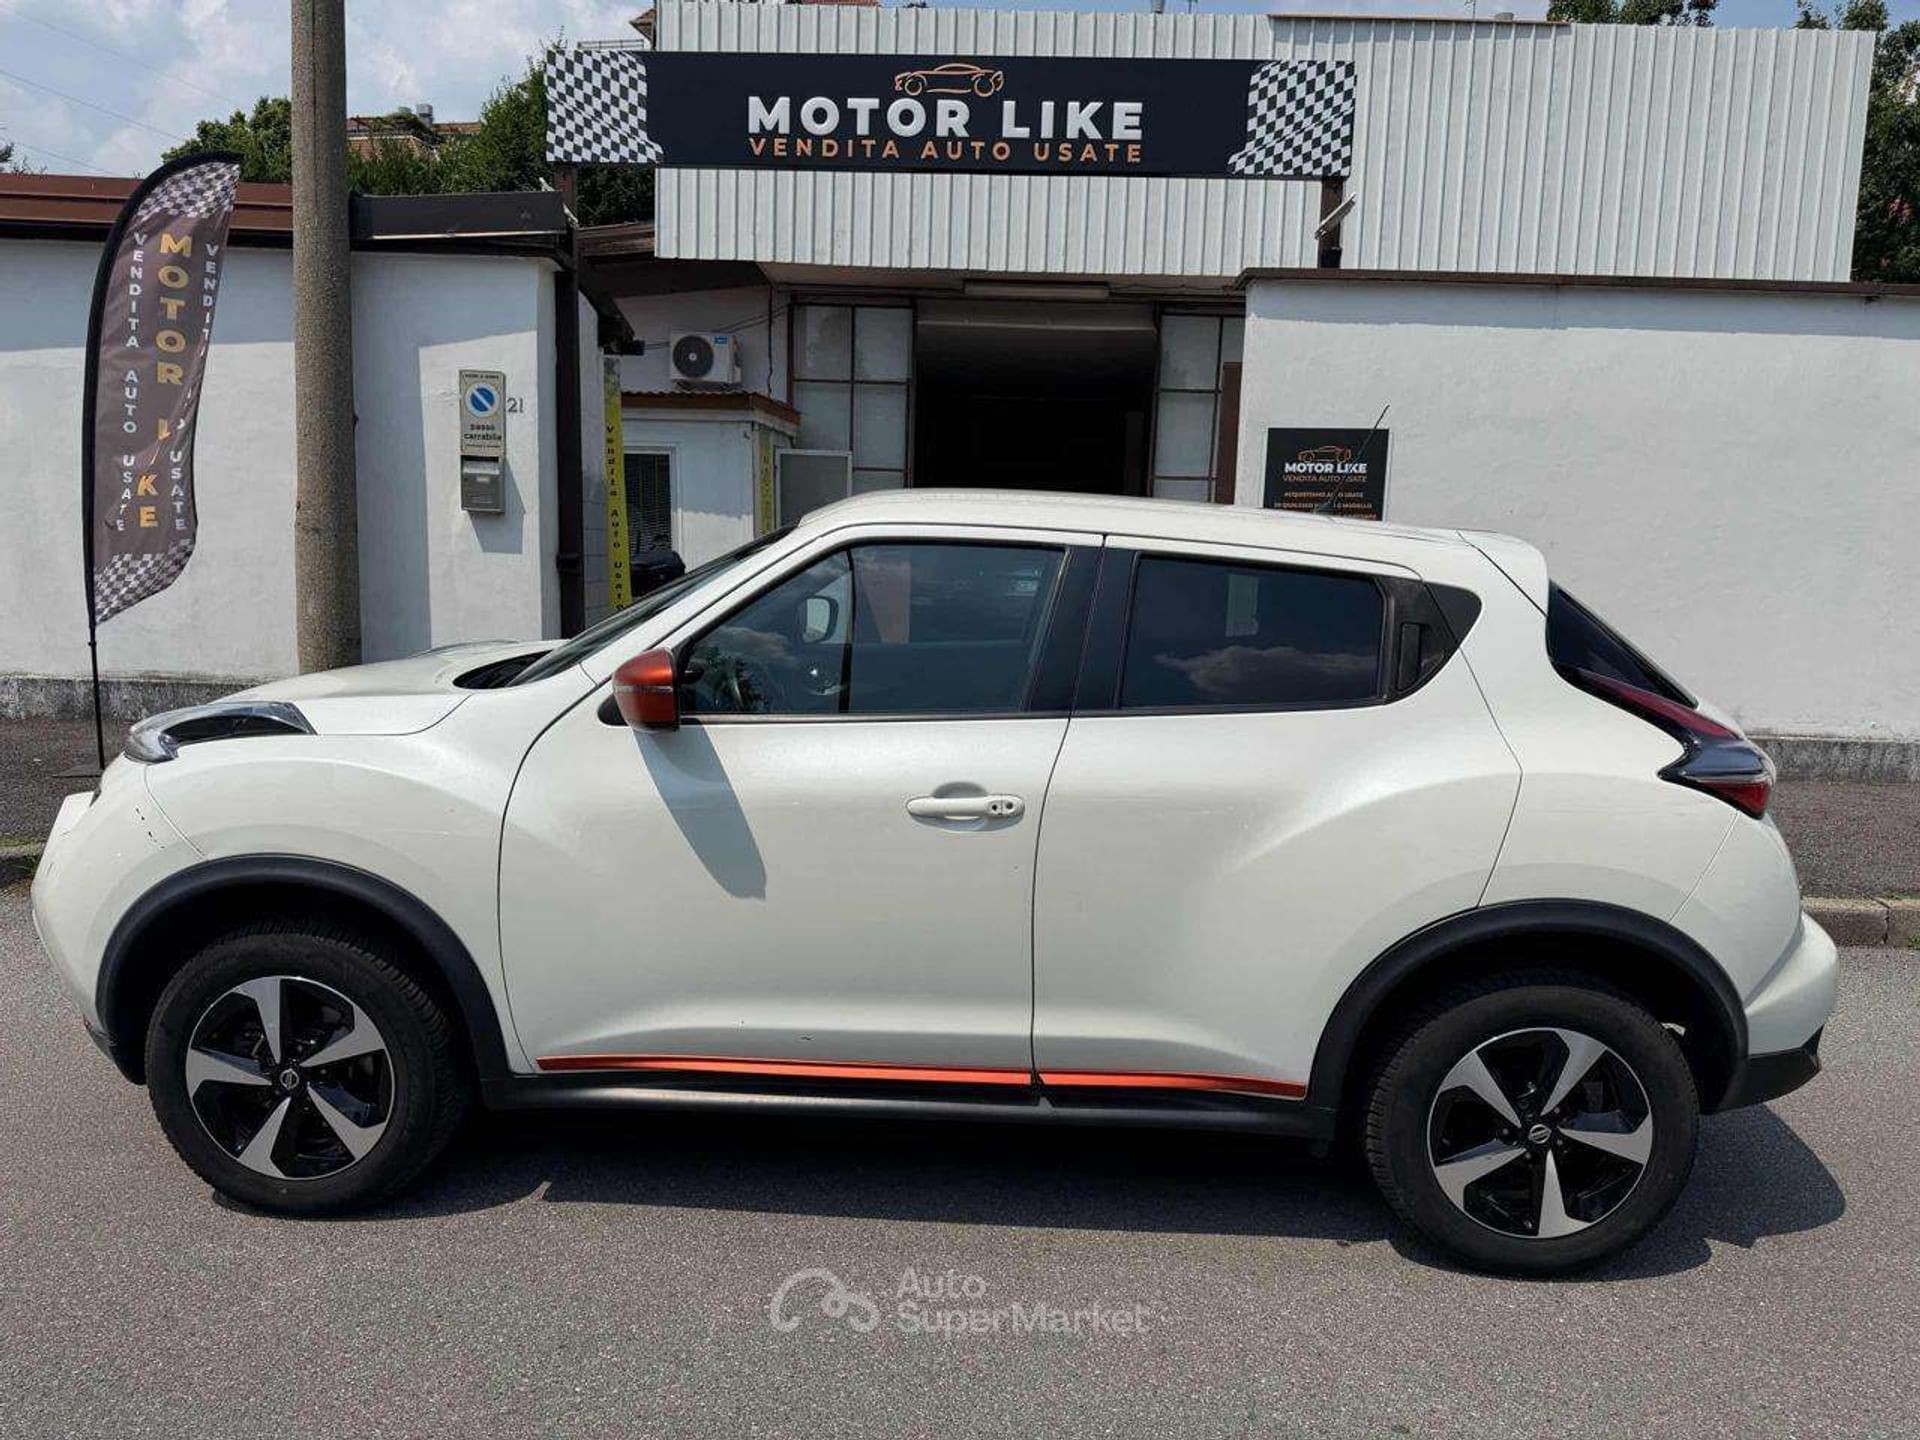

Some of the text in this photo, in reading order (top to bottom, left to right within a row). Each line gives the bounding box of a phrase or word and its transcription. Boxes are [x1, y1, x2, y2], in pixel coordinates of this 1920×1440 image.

[748, 95, 1143, 140] MOTOR LIKE
[748, 137, 1142, 163] VENDITA AUTO USATE
[155, 232, 193, 386] MOTOR
[115, 232, 149, 532] VENDITA AUTO USATE
[507, 397, 524, 413] 21
[136, 418, 172, 529] LKE
[169, 450, 187, 530] USATE
[1284, 462, 1368, 474] MOTOR LIKE
